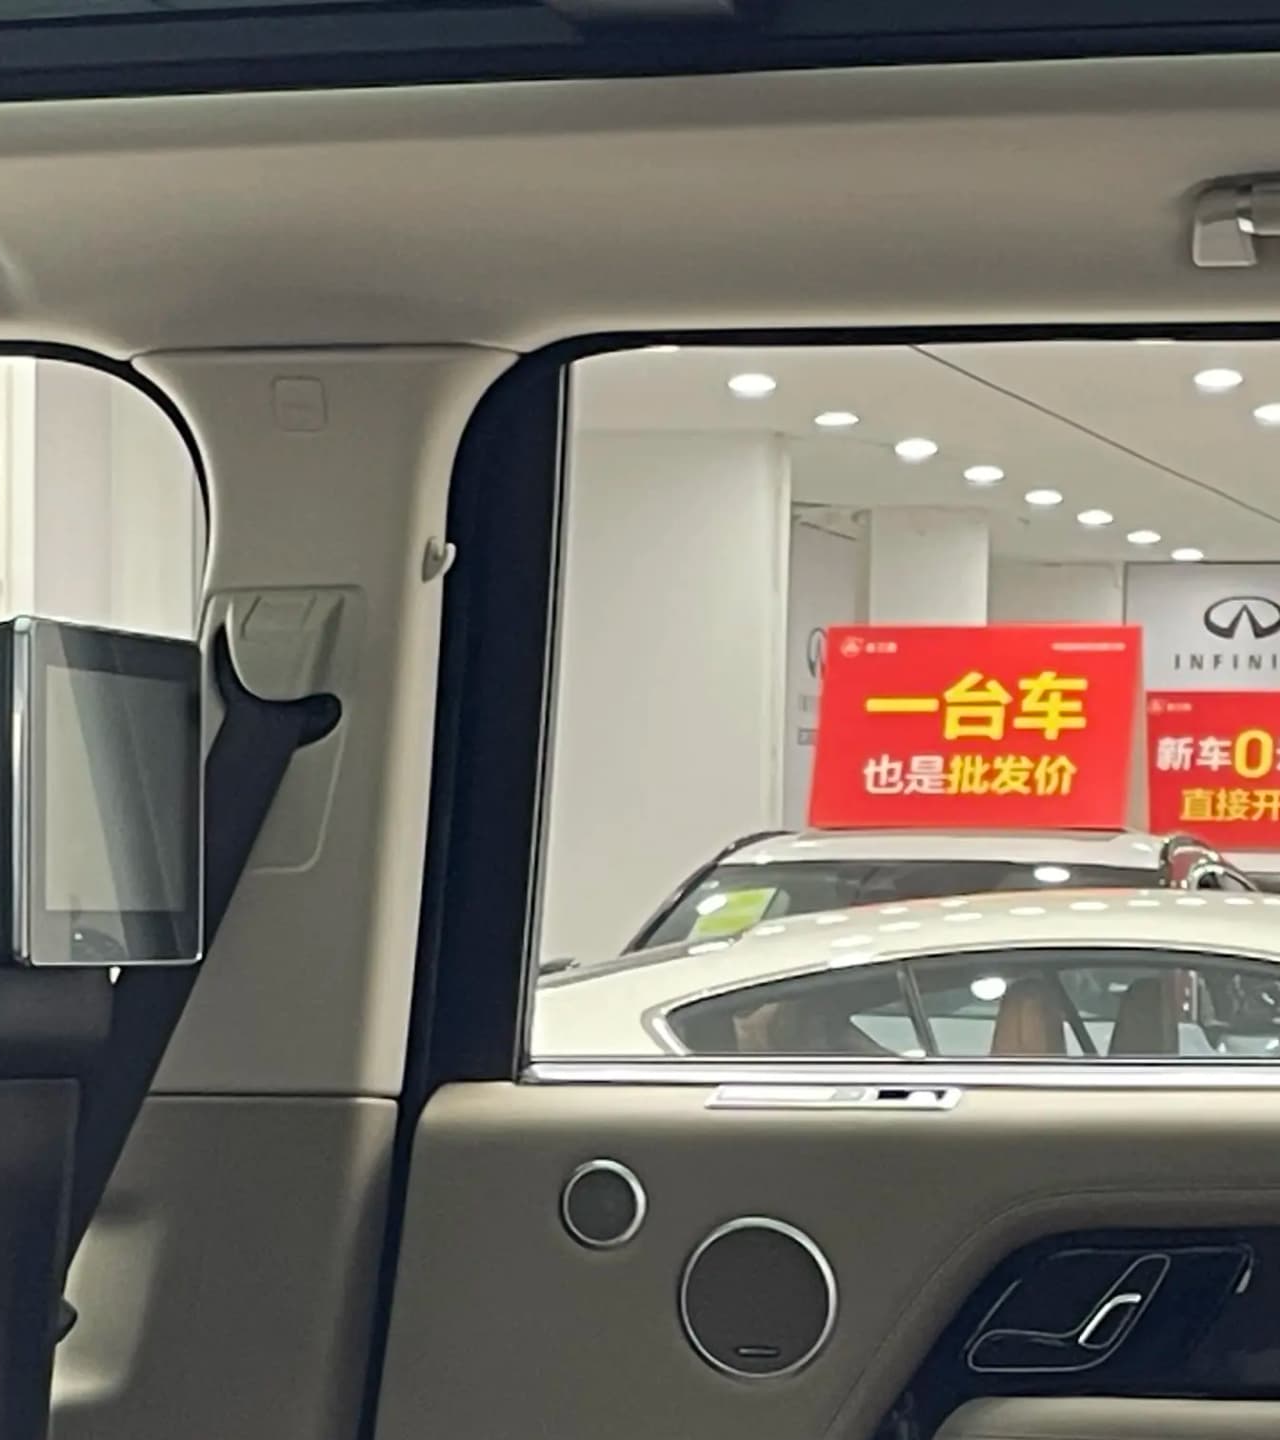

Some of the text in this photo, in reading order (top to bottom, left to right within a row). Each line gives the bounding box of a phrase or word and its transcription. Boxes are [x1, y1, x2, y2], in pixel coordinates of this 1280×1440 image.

[865, 670, 1088, 741] 一台车
[863, 753, 1077, 796] 也是批发价
